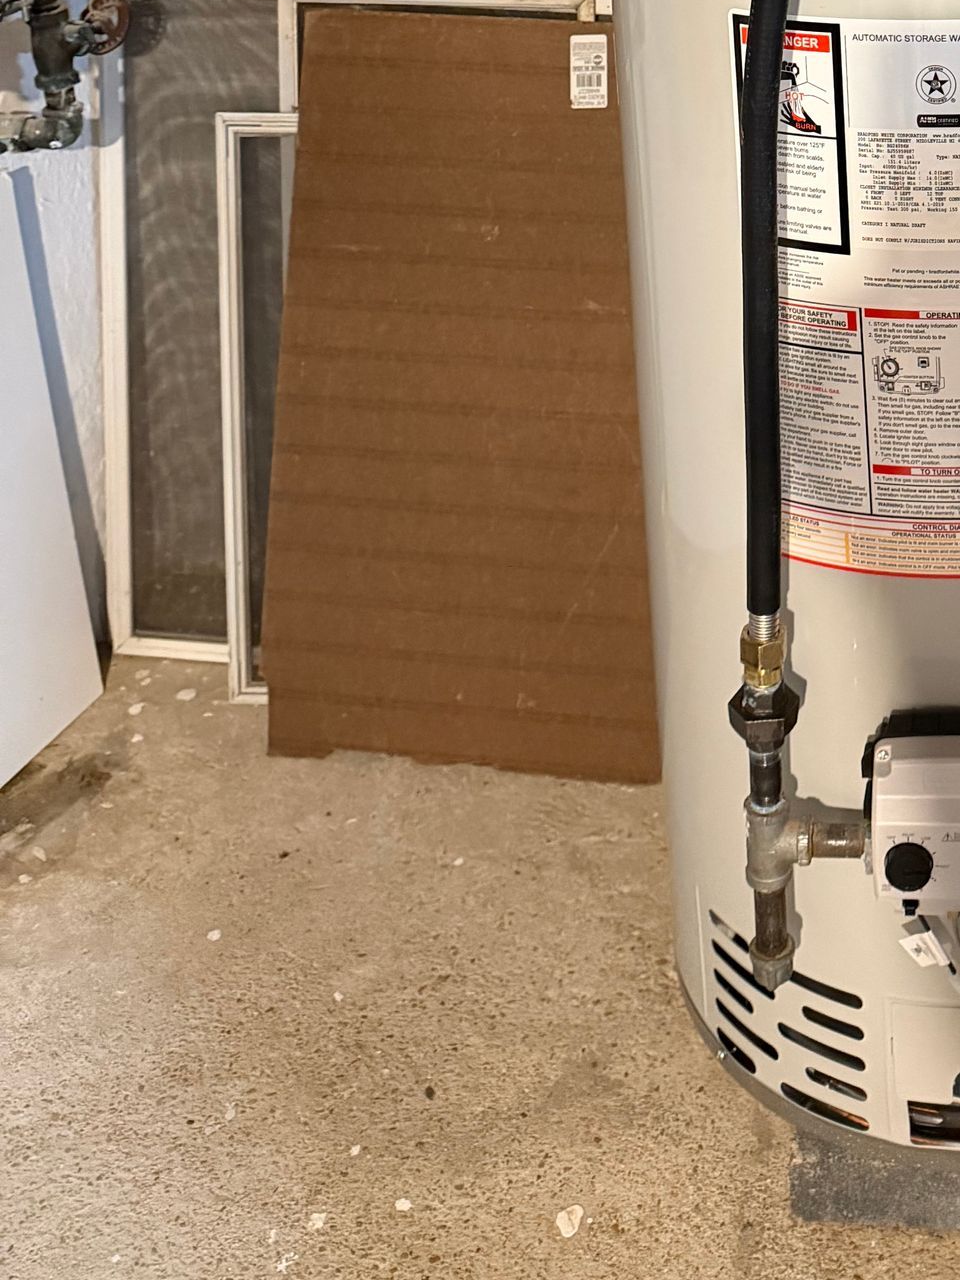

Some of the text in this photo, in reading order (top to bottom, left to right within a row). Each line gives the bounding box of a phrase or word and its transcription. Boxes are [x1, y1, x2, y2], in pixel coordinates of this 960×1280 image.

[783, 36, 818, 48] NGER
[852, 33, 902, 42] AUTOMATIC
[904, 34, 947, 42] STORAGE
[785, 92, 804, 100] HOT
[787, 307, 806, 315] YOUR
[807, 309, 832, 319] SAFETY
[781, 312, 846, 327] BEFORE OPERATING
[892, 531, 932, 539] OPERATIONAL
